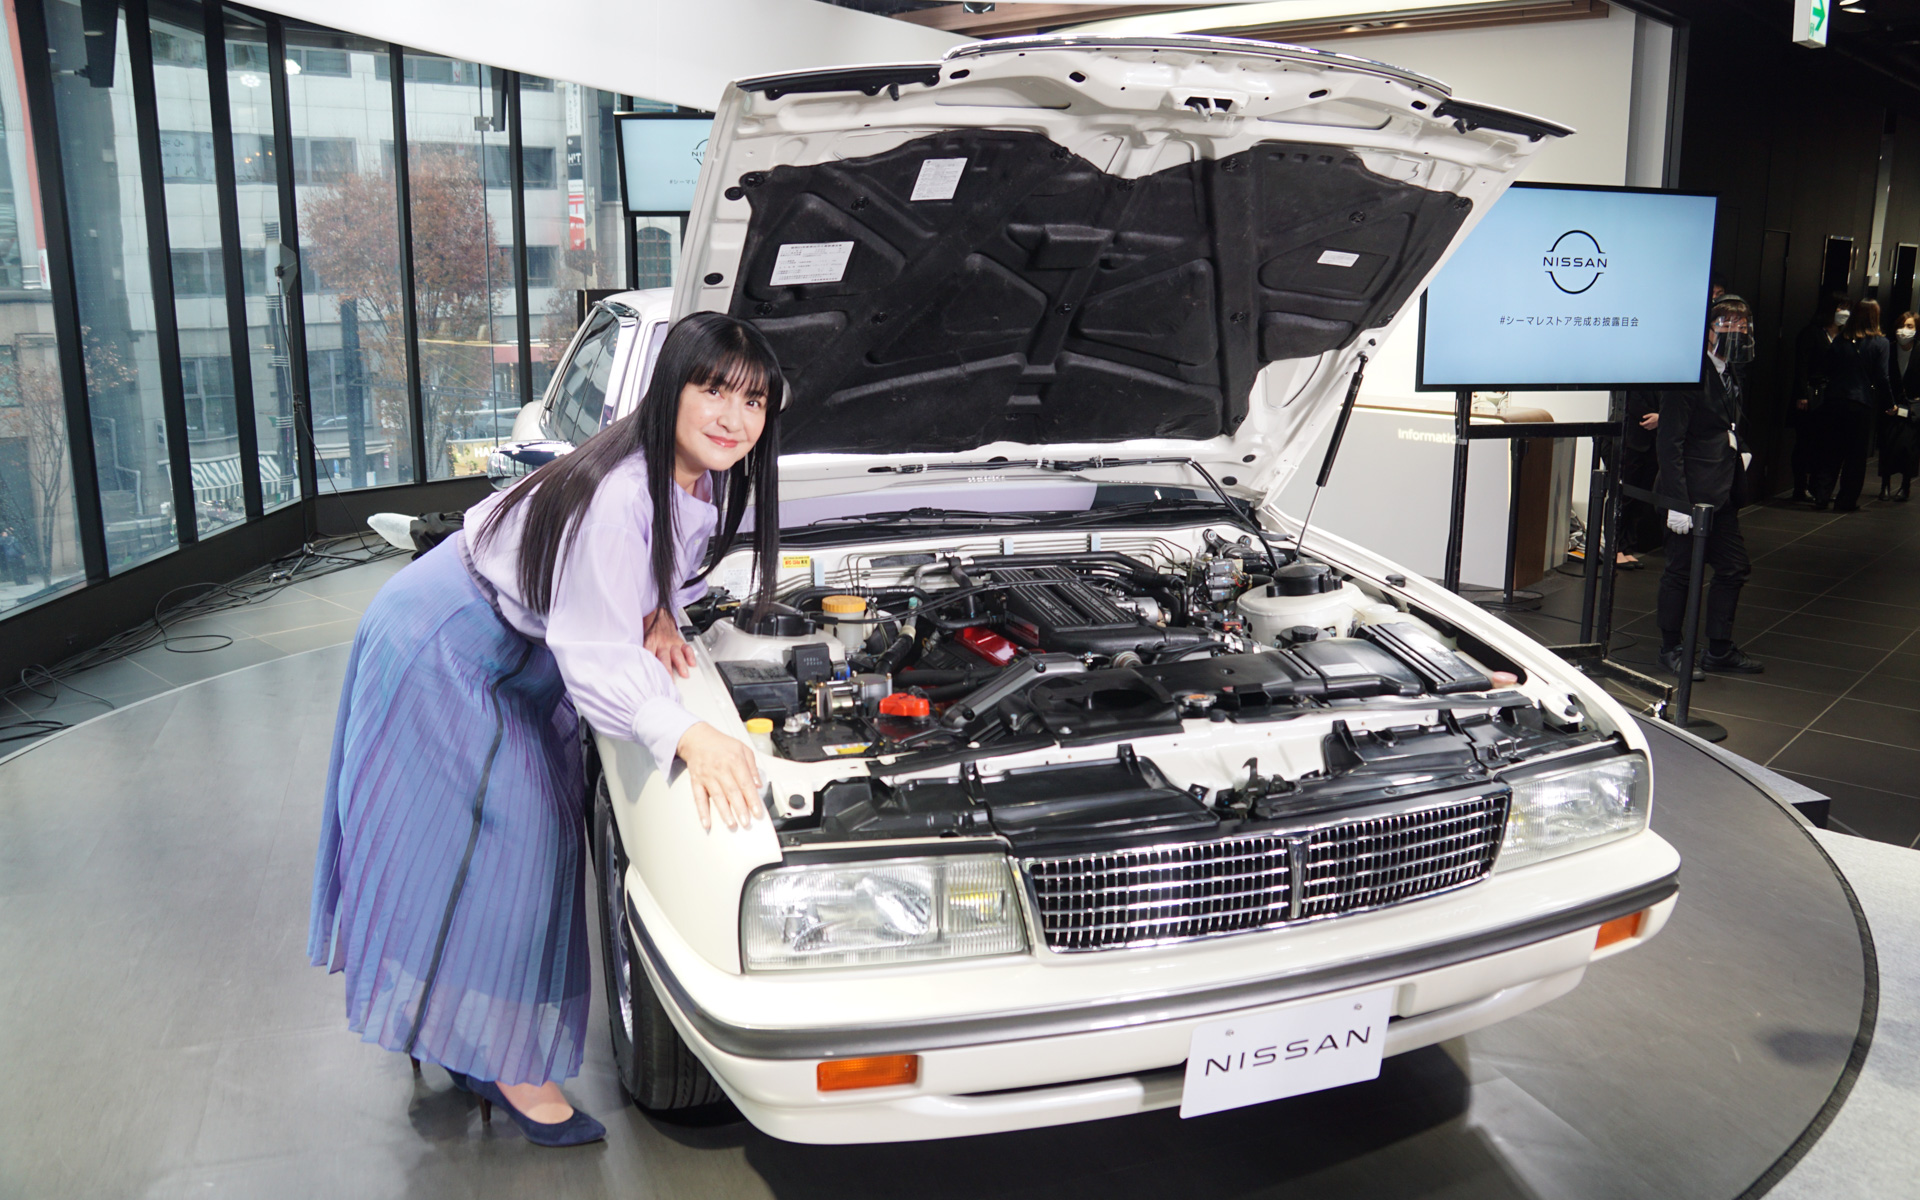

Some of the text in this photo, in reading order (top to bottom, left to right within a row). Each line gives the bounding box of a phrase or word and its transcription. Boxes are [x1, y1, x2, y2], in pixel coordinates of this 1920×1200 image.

[1542, 256, 1608, 268] NISSAN
[1499, 315, 1640, 328] #シーマレストア完成お披露目会
[1204, 1025, 1372, 1077] NISSAN
